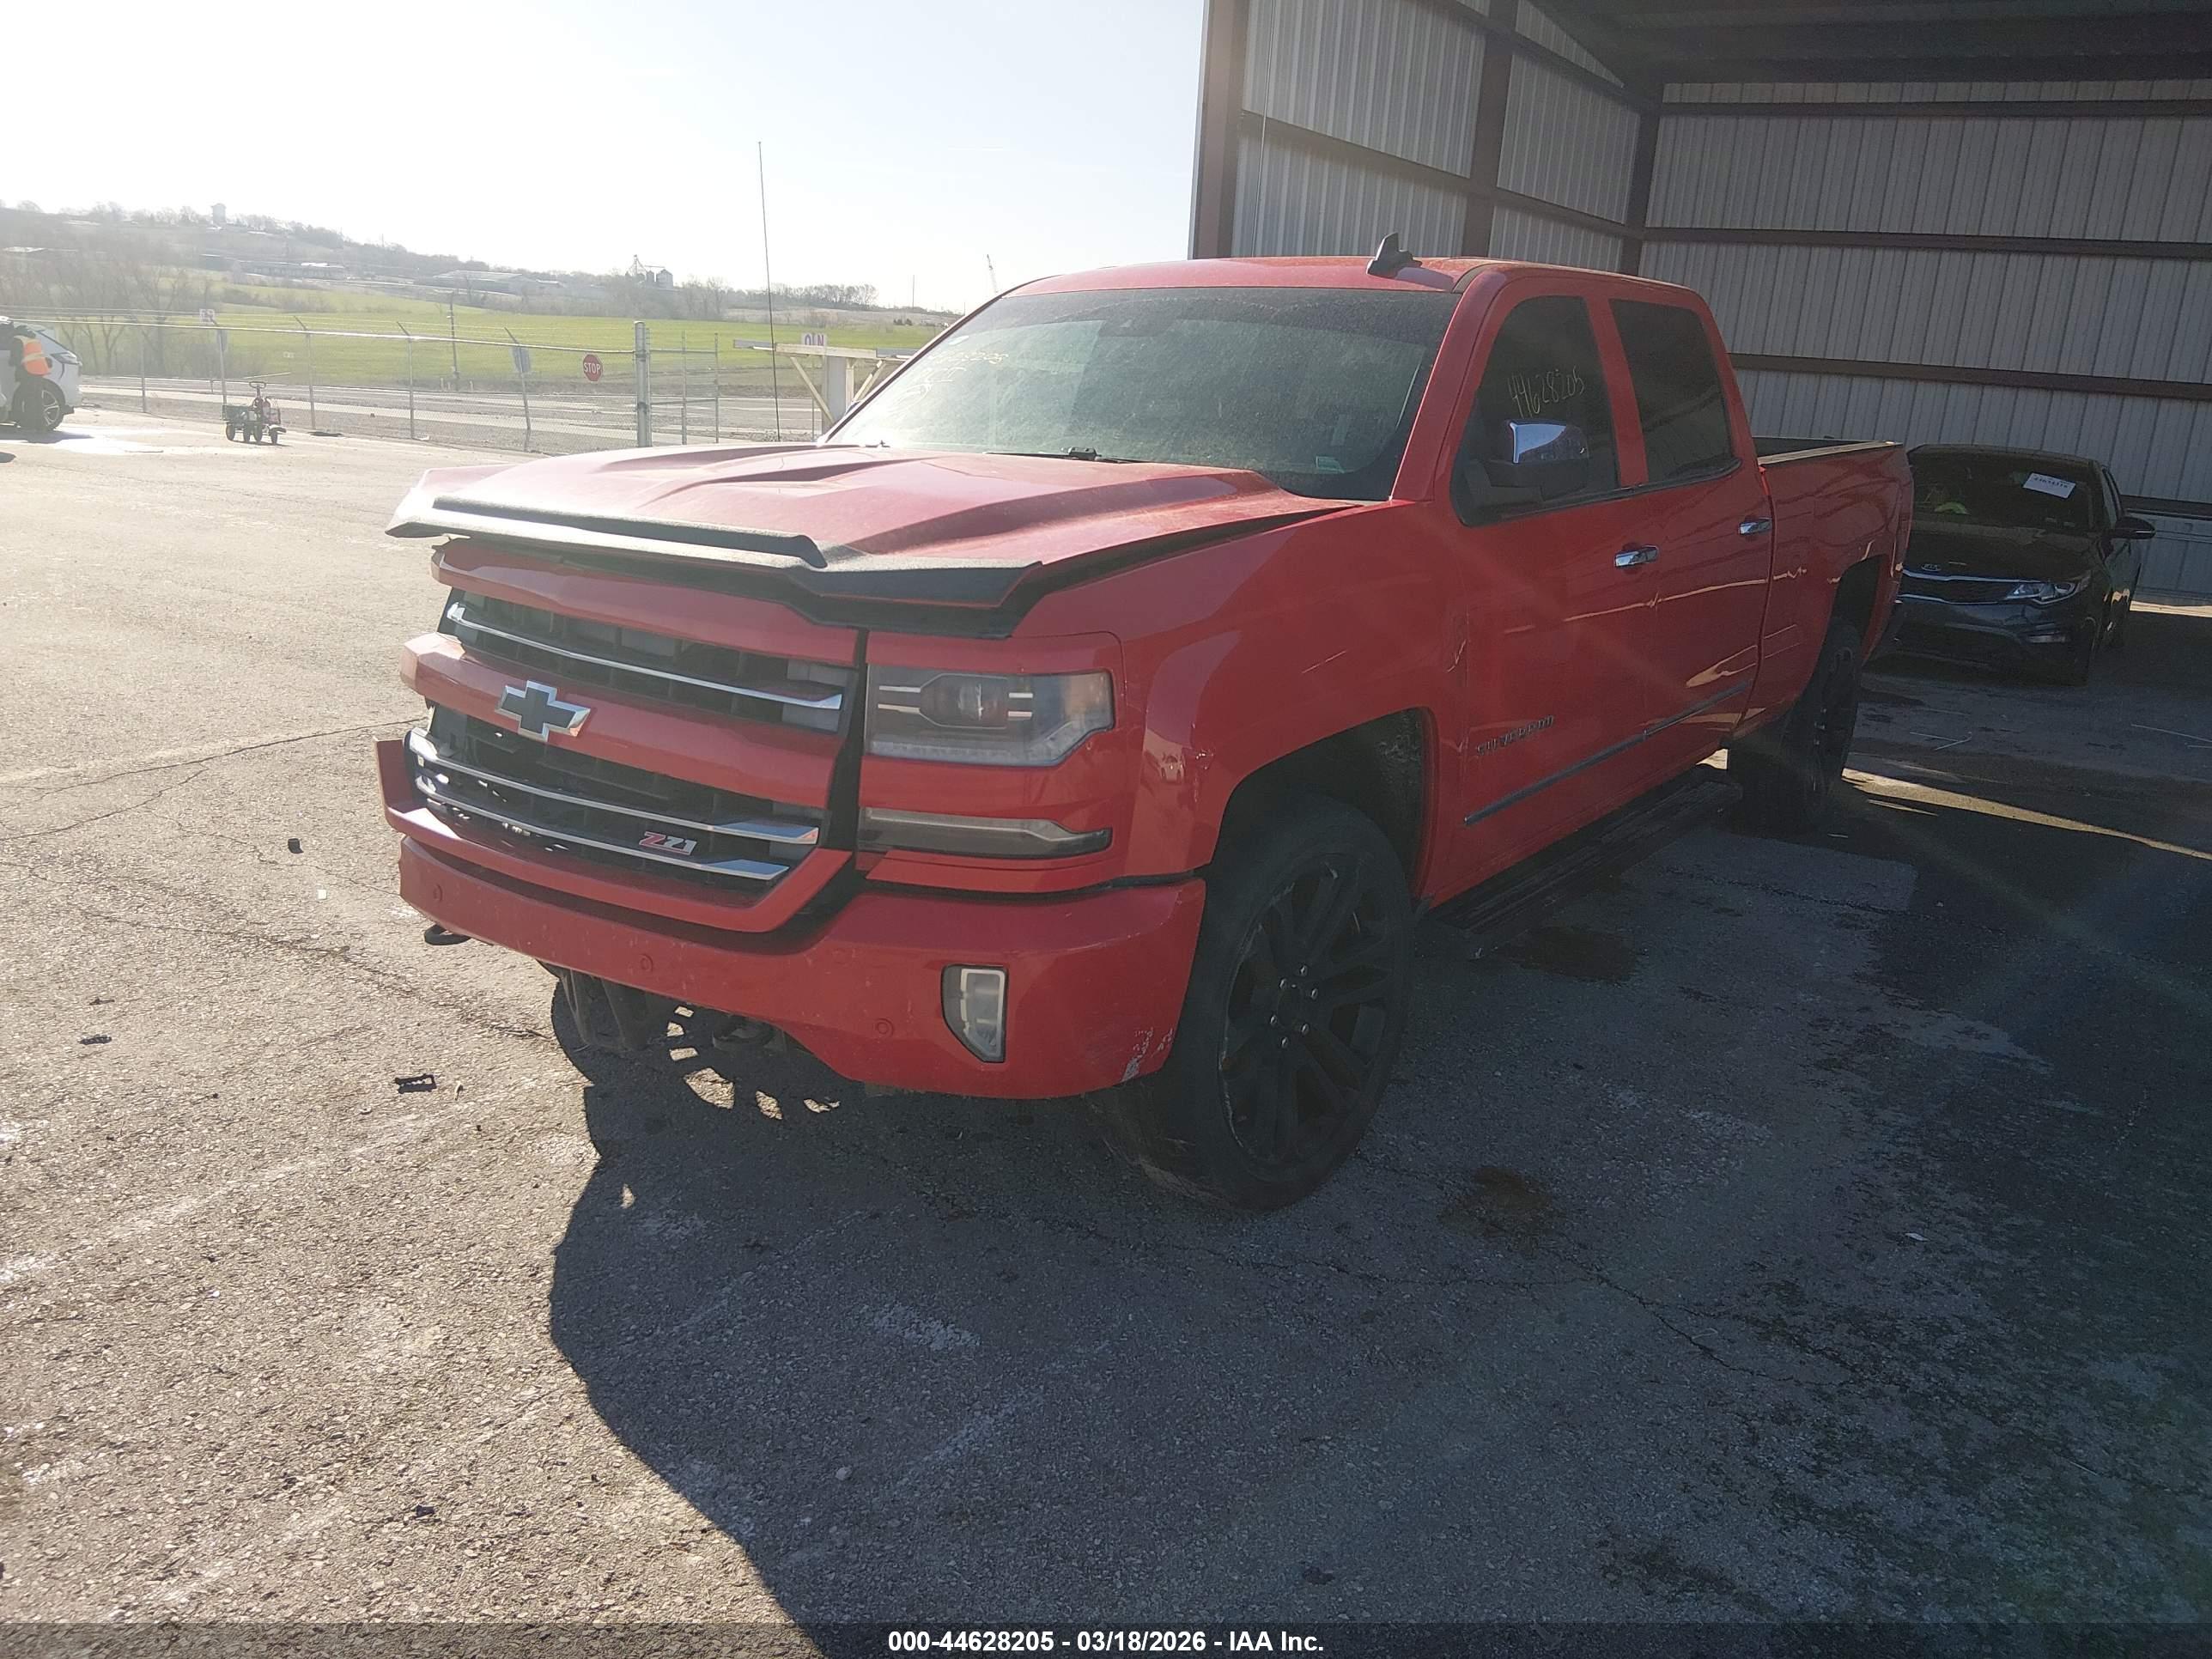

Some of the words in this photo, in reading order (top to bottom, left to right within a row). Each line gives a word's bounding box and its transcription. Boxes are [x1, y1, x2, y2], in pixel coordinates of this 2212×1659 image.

[584, 362, 601, 374] STOP
[1508, 366, 1586, 419] 44628205
[639, 830, 698, 856] Z71
